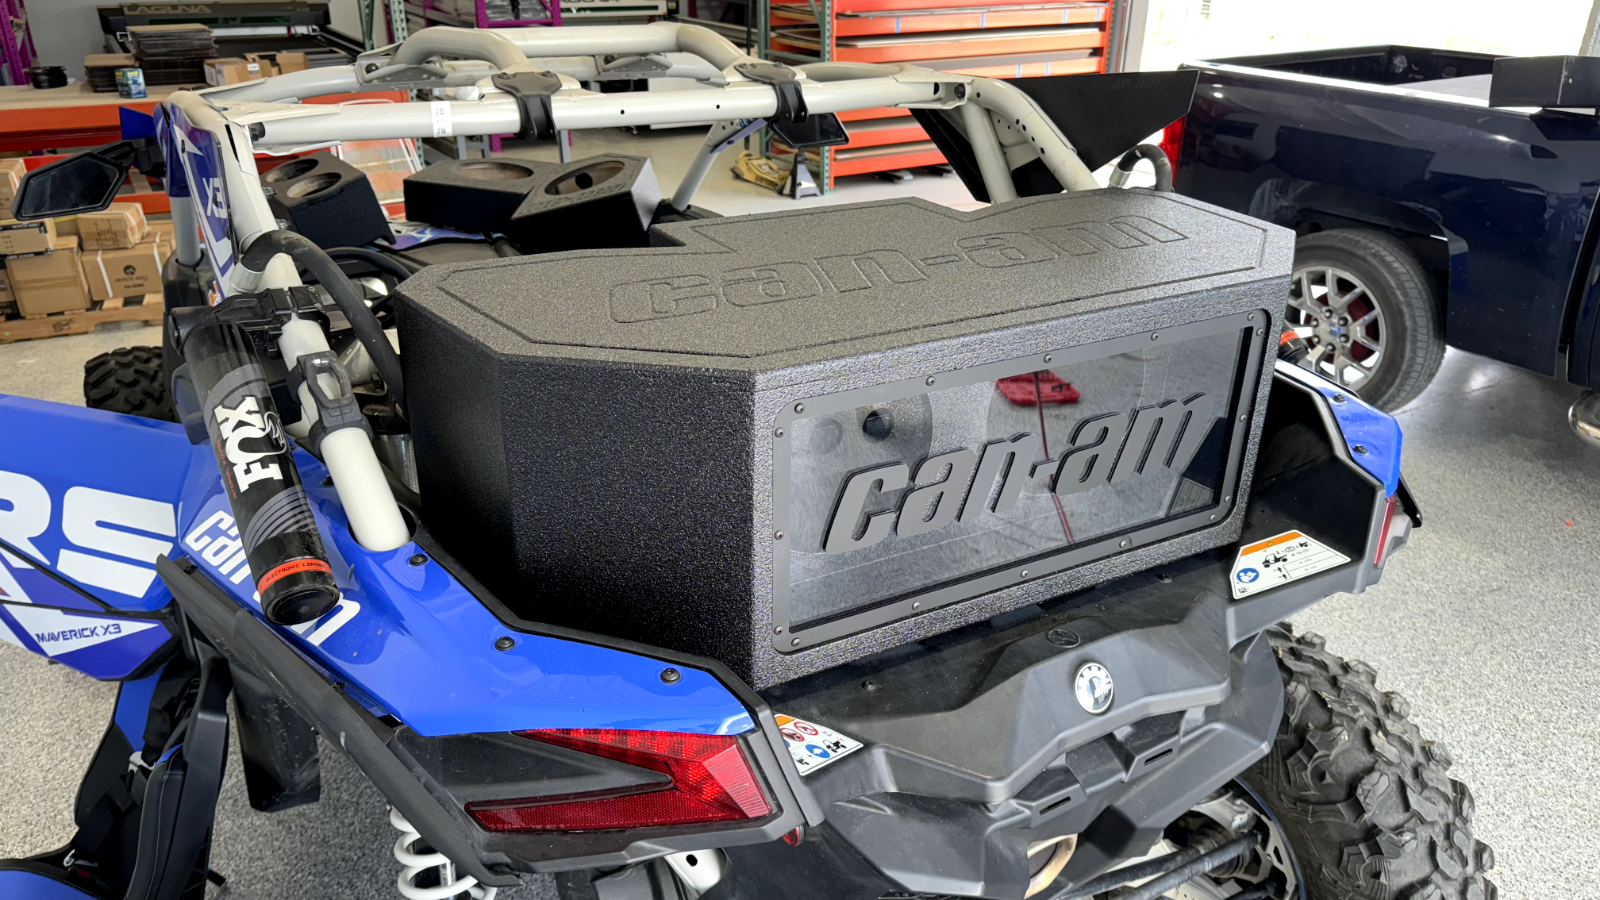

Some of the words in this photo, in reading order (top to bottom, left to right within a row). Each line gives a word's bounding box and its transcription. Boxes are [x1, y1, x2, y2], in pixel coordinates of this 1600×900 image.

[123, 4, 213, 16] LAGUNA
[202, 177, 228, 219] X3
[214, 396, 286, 493] FOX
[265, 563, 301, 583] ELECTRONIC
[35, 625, 100, 644] MAVERICK
[100, 623, 122, 635] X3
